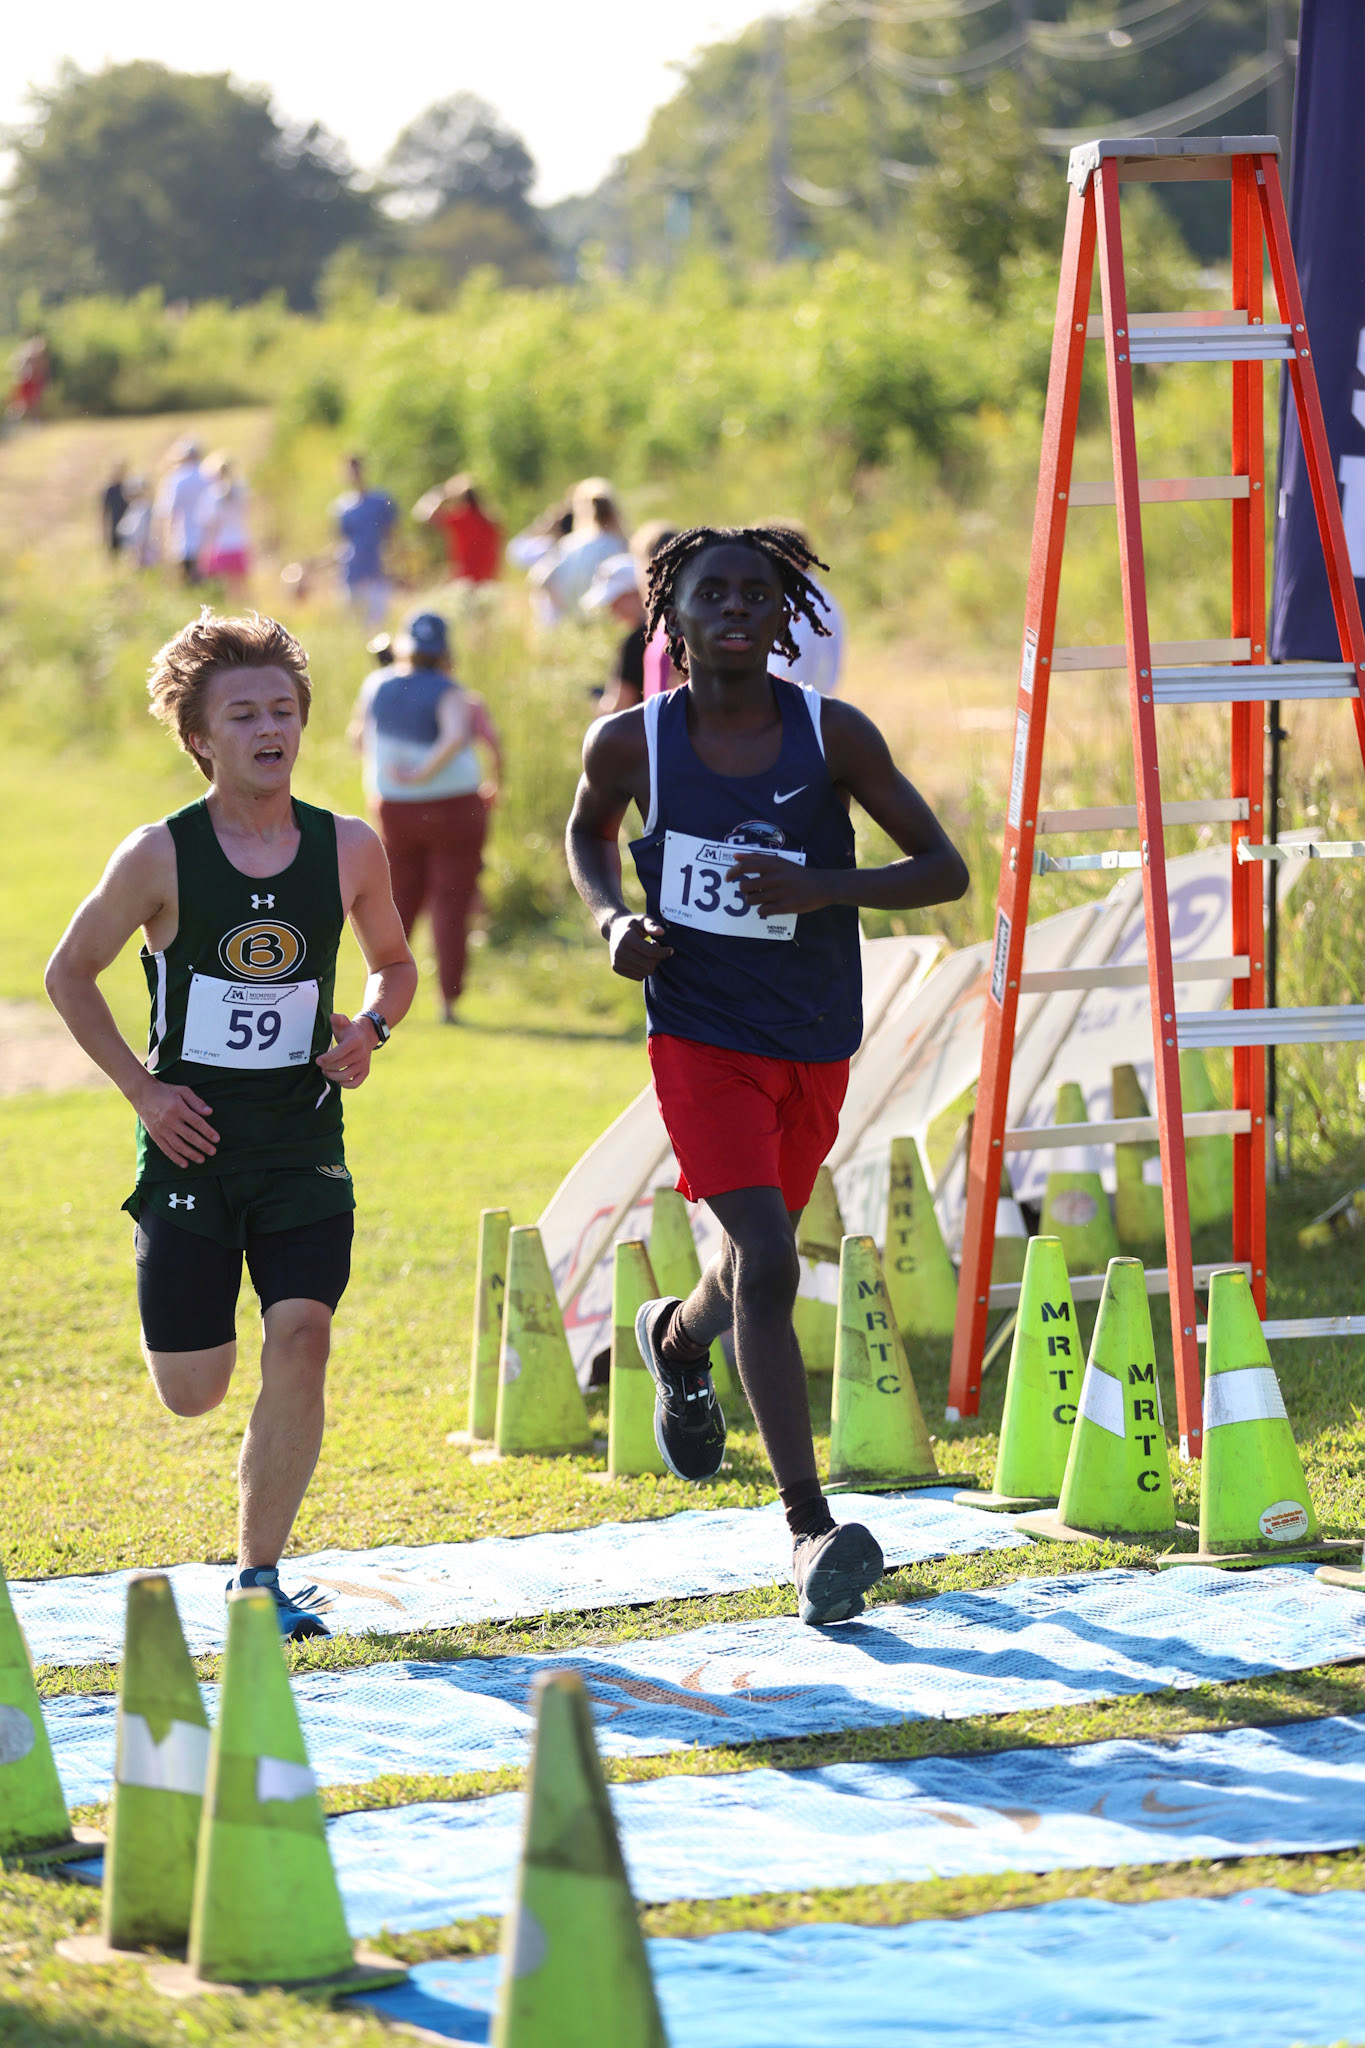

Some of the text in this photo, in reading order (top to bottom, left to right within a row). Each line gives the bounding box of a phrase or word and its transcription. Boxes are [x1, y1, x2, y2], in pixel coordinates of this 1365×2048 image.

[703, 848, 717, 859] M
[240, 931, 285, 968] B
[230, 989, 244, 1000] M
[225, 1009, 281, 1051] 59
[857, 1280, 902, 1395] MRTC
[1041, 1302, 1078, 1425] MRTC
[1127, 1363, 1161, 1493] MRTC
